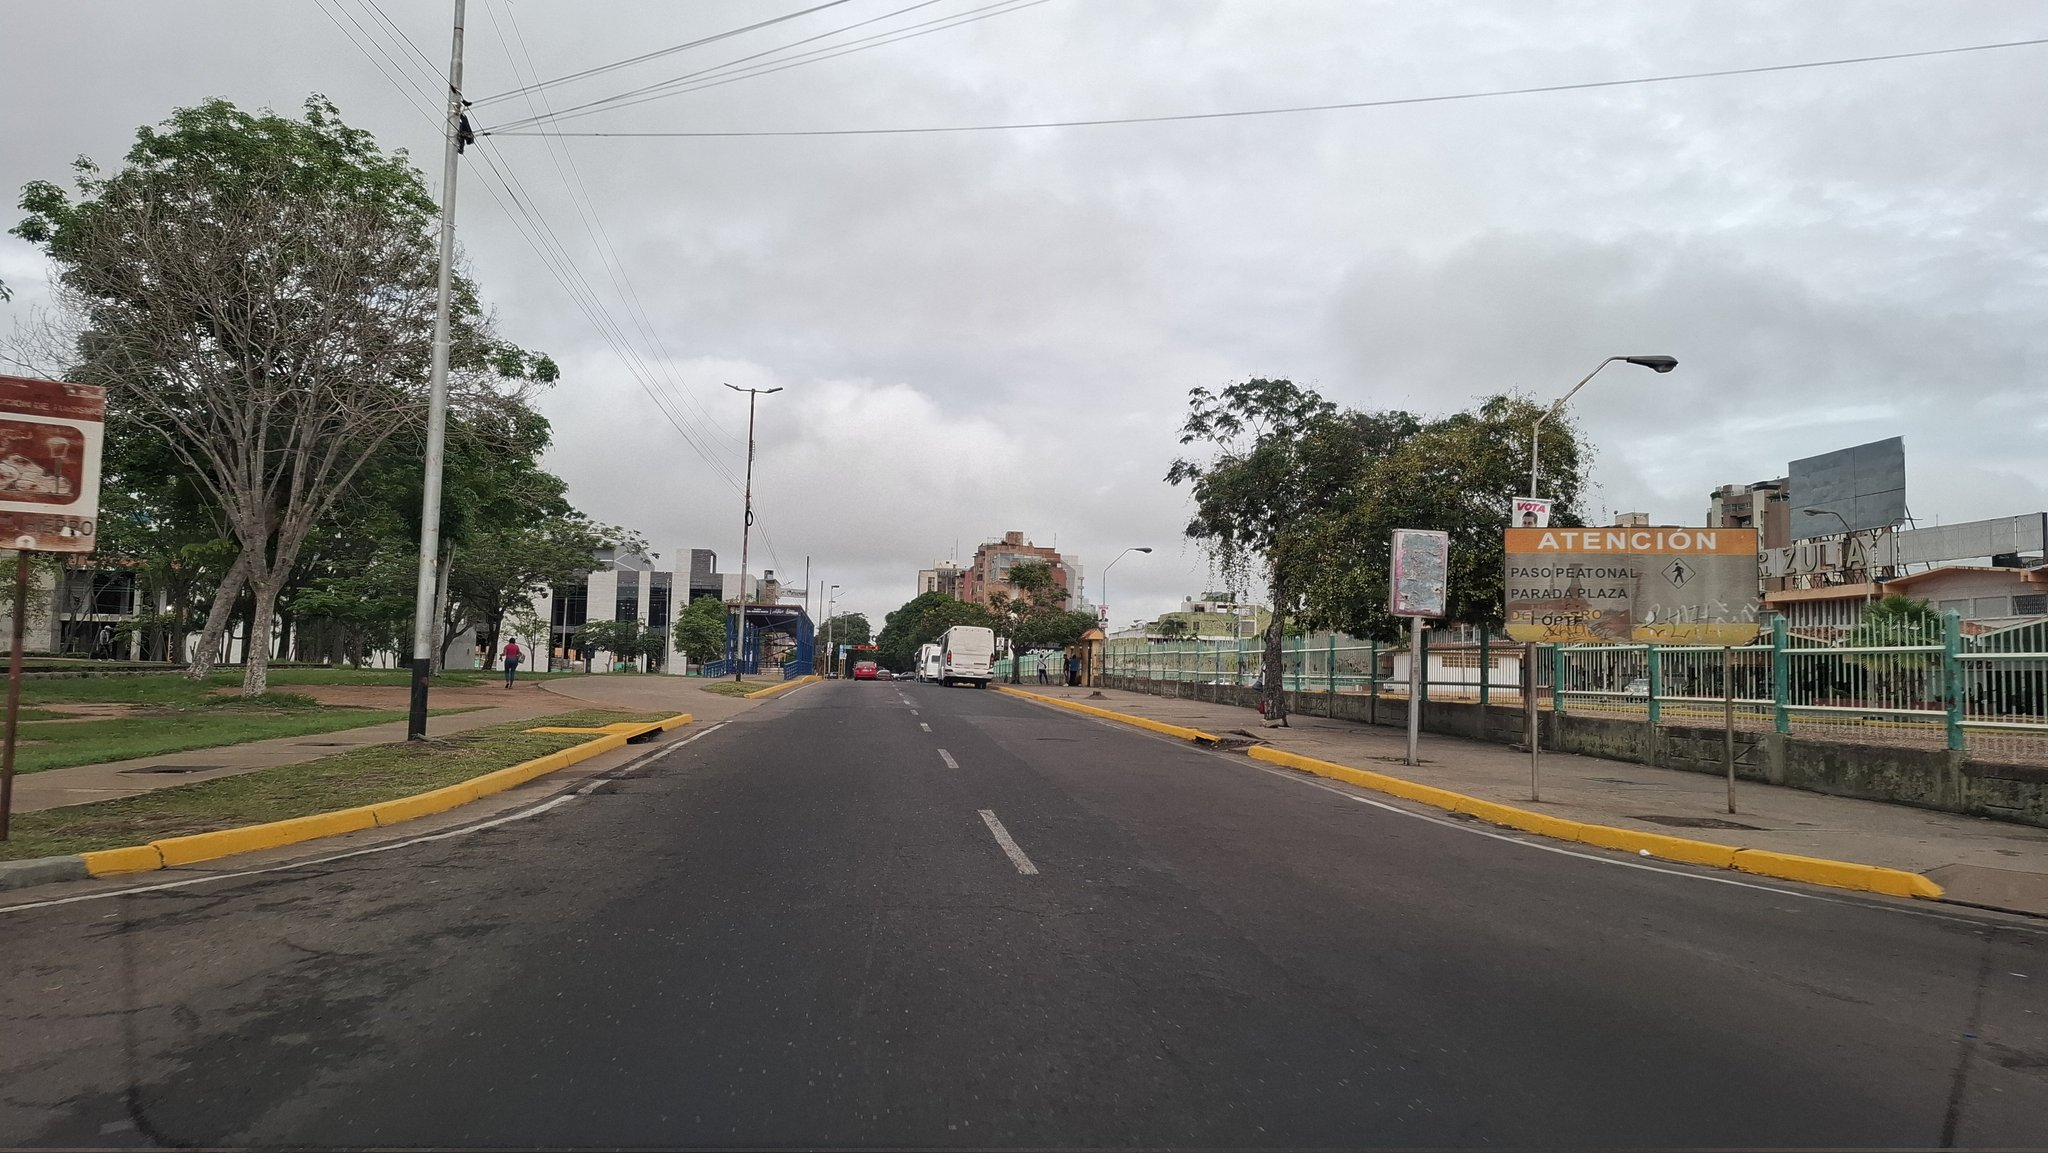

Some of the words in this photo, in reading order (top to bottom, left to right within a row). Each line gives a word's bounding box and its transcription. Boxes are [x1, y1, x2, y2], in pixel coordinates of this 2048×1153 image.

[1517, 502, 1546, 513] VOTA
[1538, 528, 1717, 550] ATENCIÓN
[1511, 567, 1552, 578] PASO
[1556, 567, 1640, 579] PEATONAL
[1511, 588, 1573, 599] PARADA
[1577, 588, 1628, 599] PLAZA
